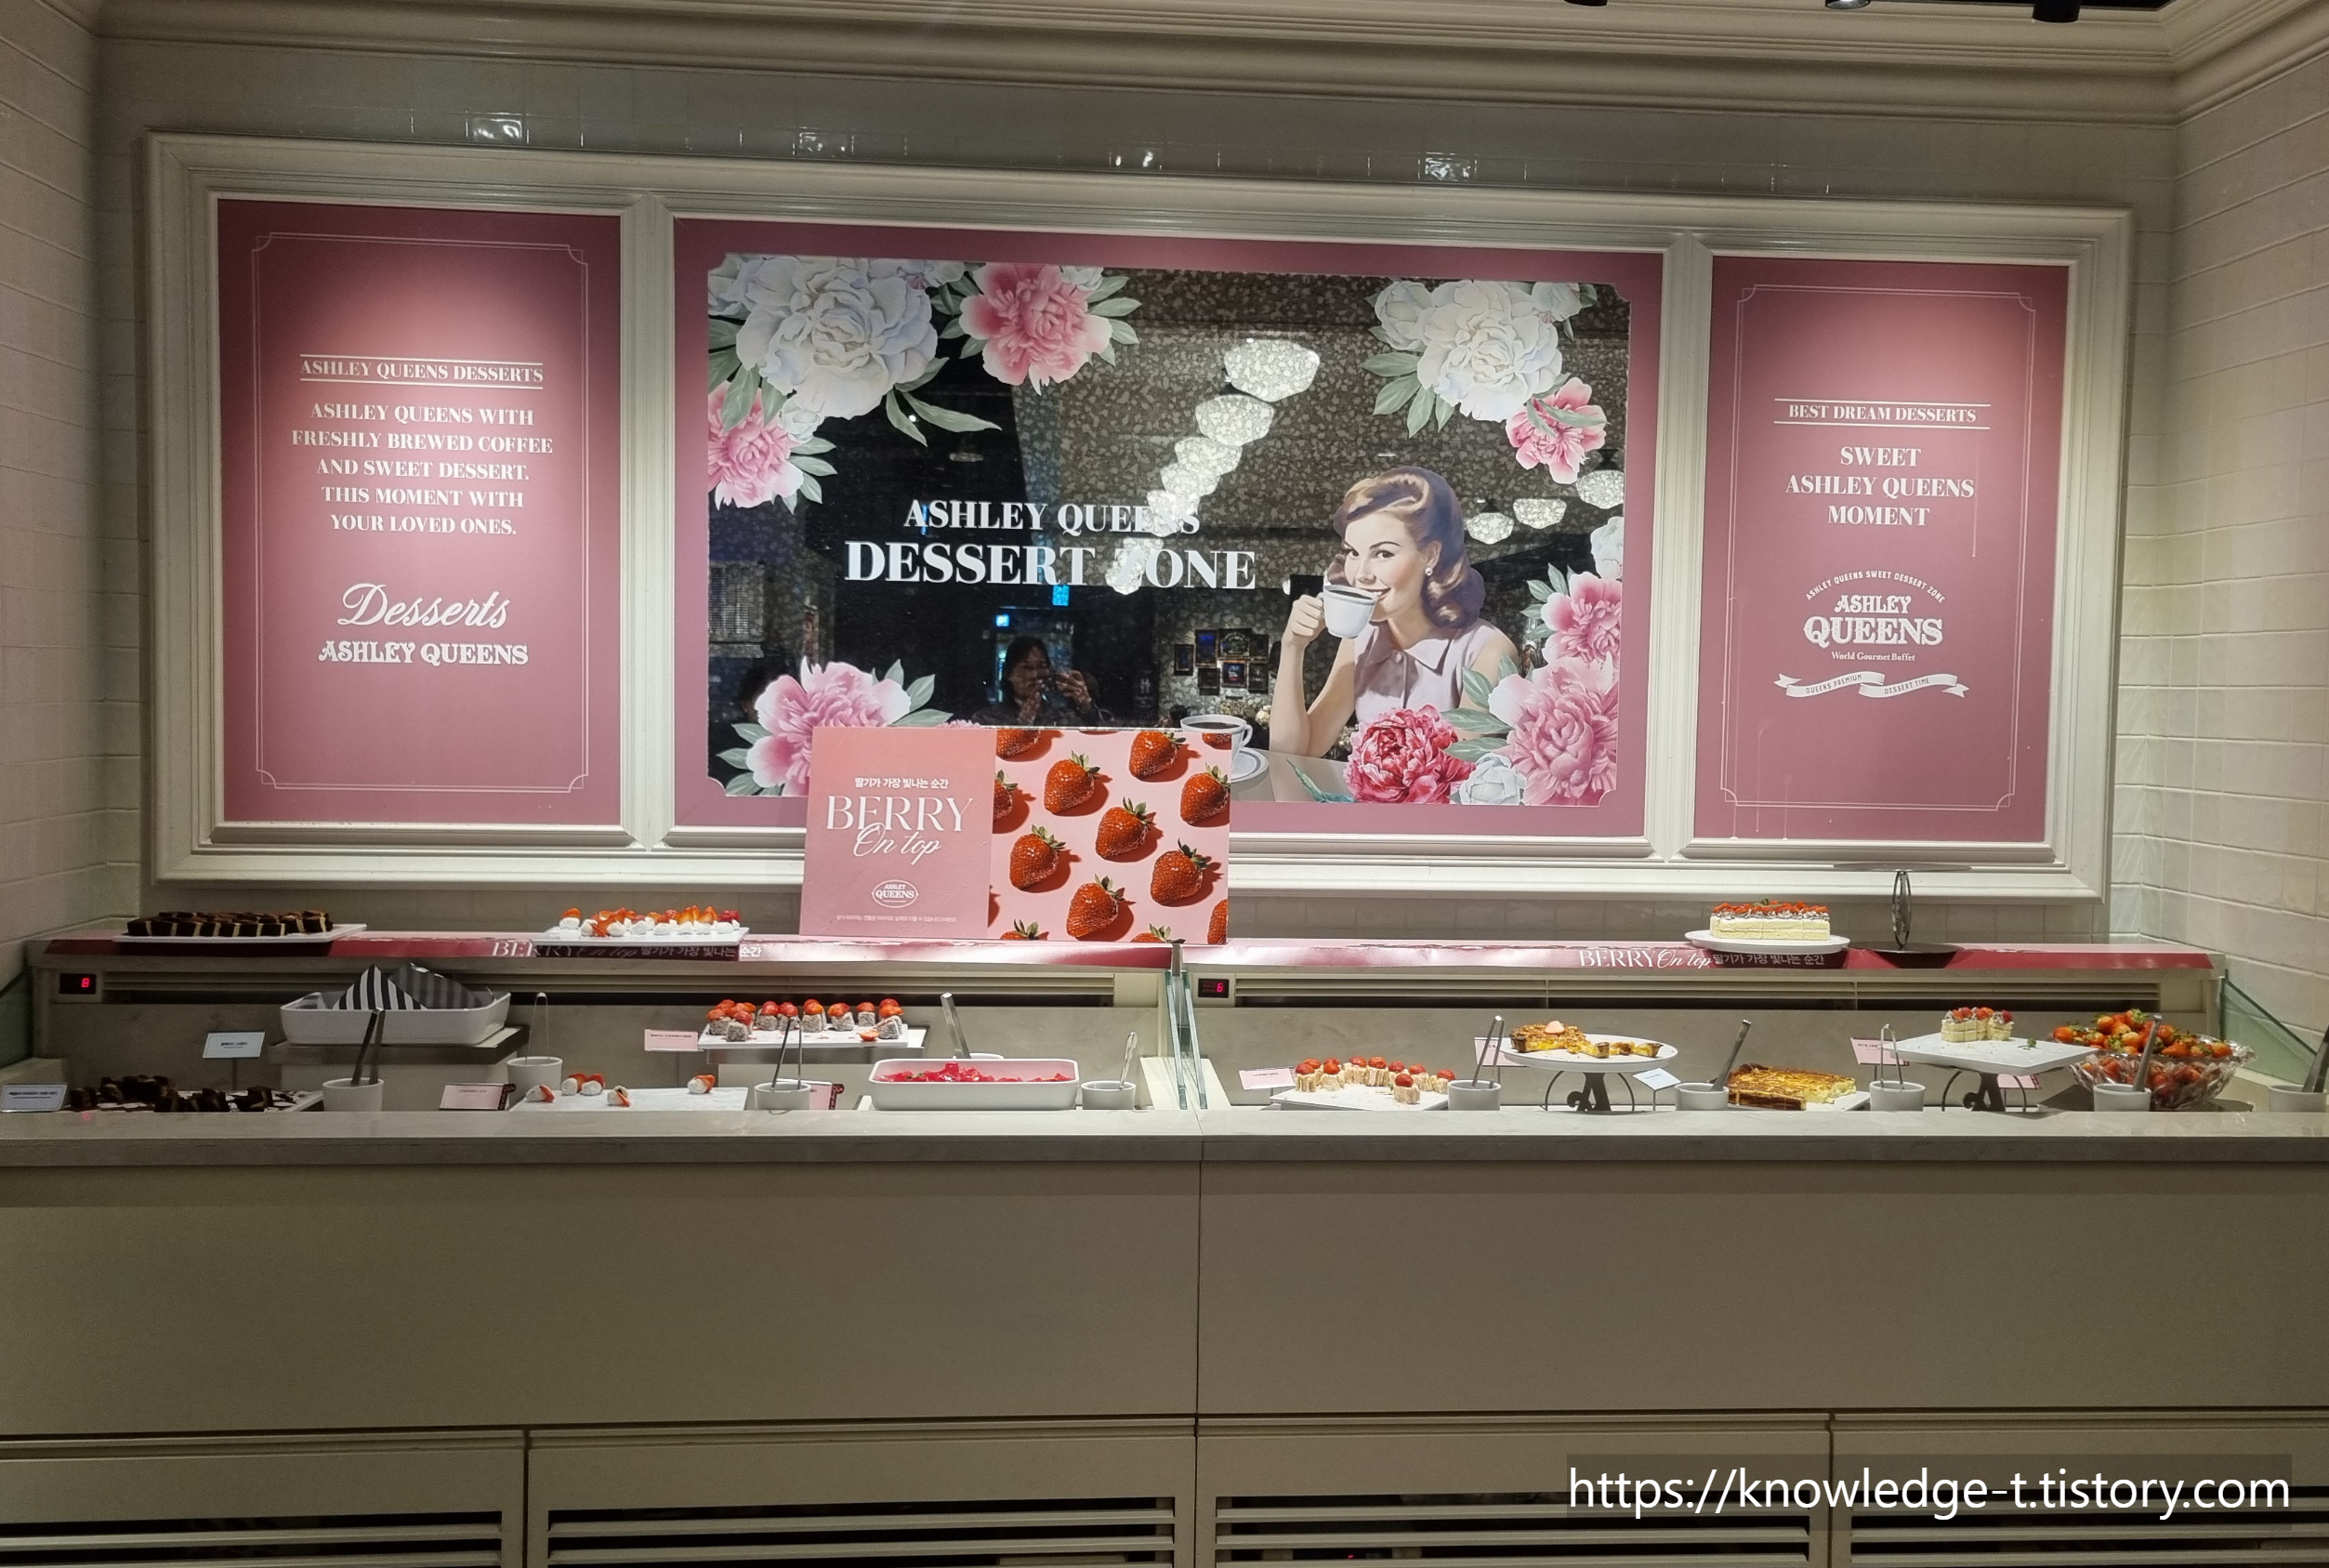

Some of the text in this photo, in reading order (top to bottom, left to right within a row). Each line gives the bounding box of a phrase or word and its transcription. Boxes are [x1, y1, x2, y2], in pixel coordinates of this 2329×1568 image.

[300, 359, 544, 384] ASHLEY QUEENS DESSERTS
[310, 402, 534, 427] ASHLEY QUEENS WITH
[1788, 403, 1977, 423] BEST DREAM DESSERTS
[291, 429, 553, 455] FRESHLY BREWED COFFEE
[1840, 446, 1921, 467] SWEET
[317, 458, 530, 481] AND SWEET DESSERT.
[322, 487, 524, 508] THIS MOMENT WITH
[1785, 475, 1974, 499] ASHLEY QUEENS
[330, 515, 517, 535] YOUR LOVED ONES.
[903, 499, 1200, 536] ASHLEY QUEENS
[1827, 506, 1929, 526] MOMENT
[844, 541, 1096, 586] DESSERT
[1806, 570, 1946, 604] ASHLEY QUEENS SWEET DESSERT ZONE
[336, 583, 511, 629] Desserts
[1834, 594, 1912, 614] ASHLEY
[1803, 615, 1944, 649] QUEENS
[318, 641, 529, 666] ASHLEY QUEENS
[1831, 651, 1915, 662] World Gourmet Buffet
[1805, 673, 1862, 694] QUEENS PREMIUM
[1884, 677, 1930, 695] DESSERT TIME
[854, 777, 949, 789] 딸기가 가장 빛나는 순간
[826, 795, 974, 832] BERRY
[853, 822, 941, 866] On top
[875, 889, 914, 900] QUEENS
[677, 946, 699, 956] 가장
[740, 946, 762, 957] 순간
[1579, 949, 1713, 968] BERRY On top
[1714, 954, 1824, 966] 딸기가 가장 빛나는 순간
[1217, 982, 1223, 993] 6
